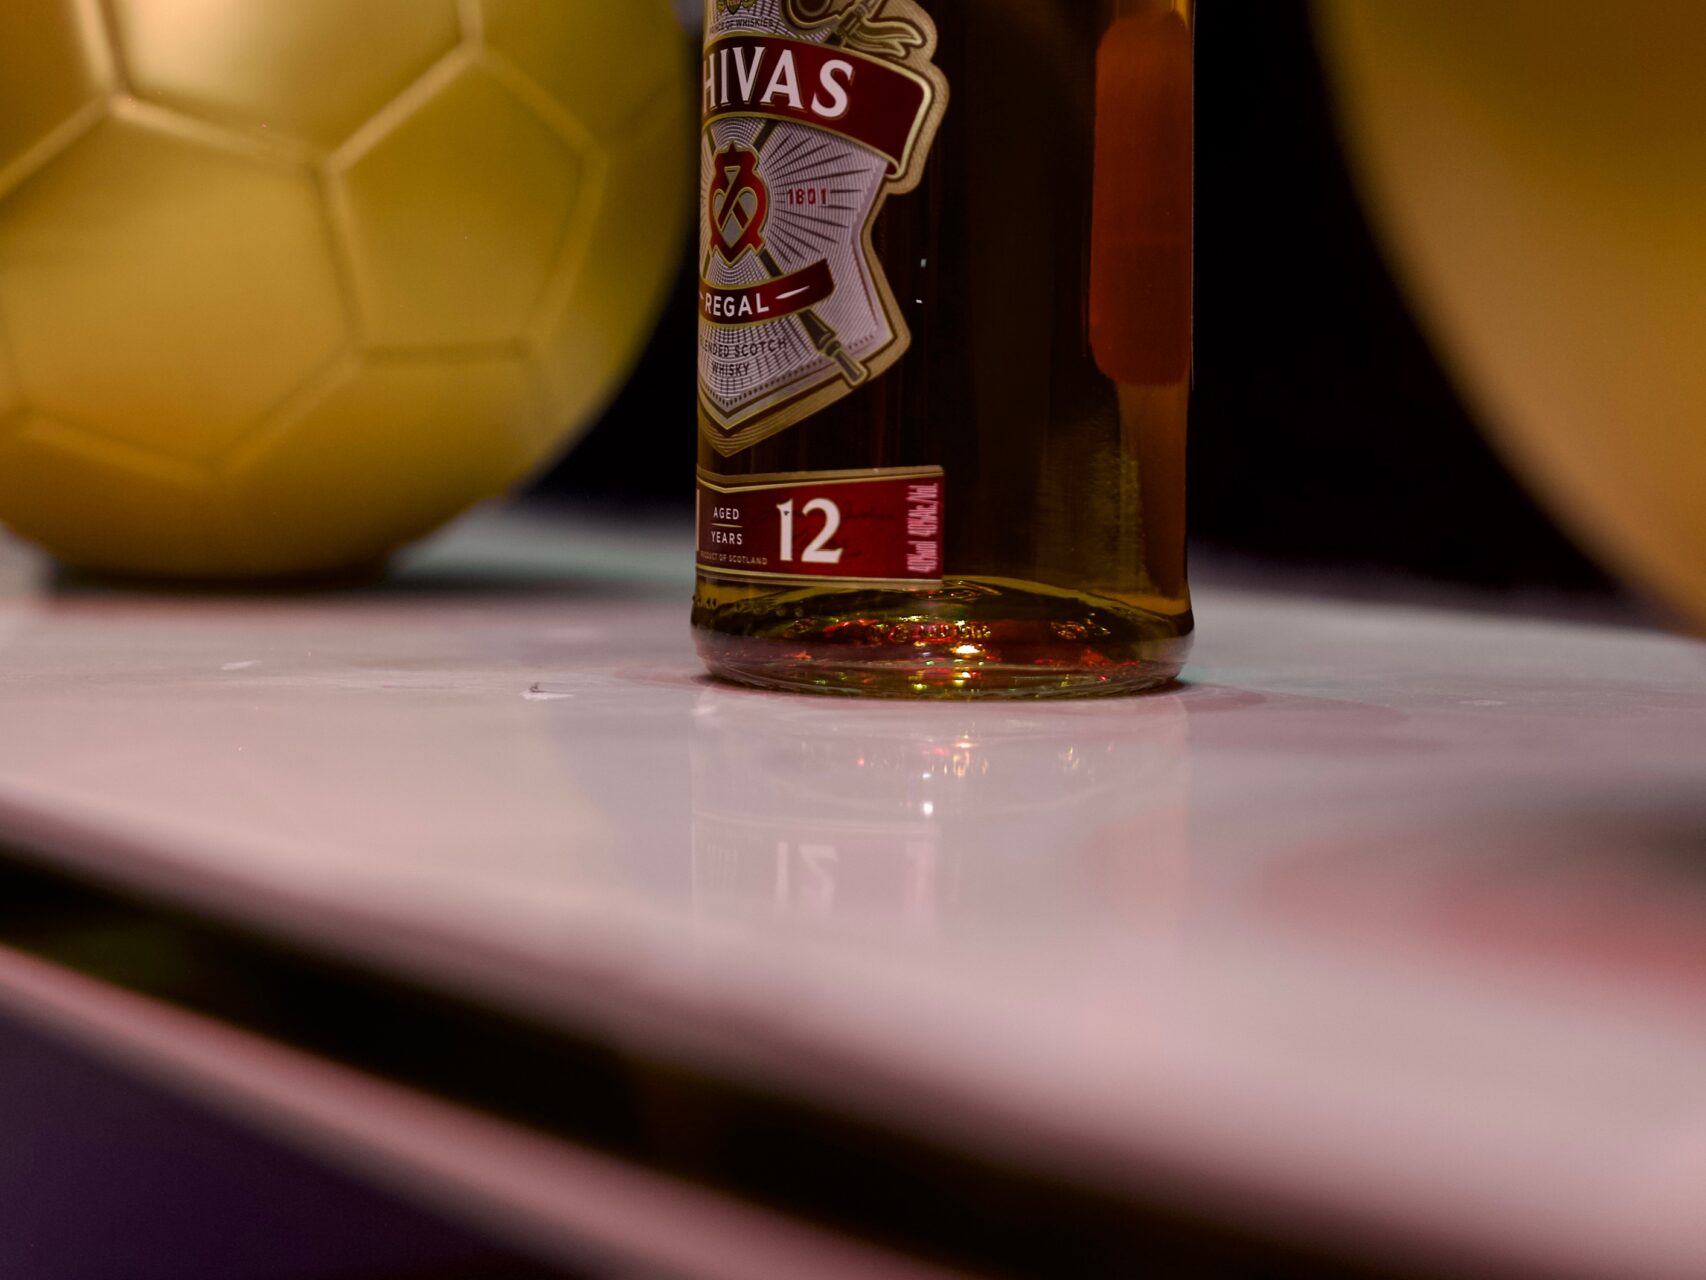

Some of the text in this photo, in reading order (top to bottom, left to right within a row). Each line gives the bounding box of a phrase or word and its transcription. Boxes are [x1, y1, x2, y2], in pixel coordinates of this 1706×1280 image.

[787, 187, 828, 205] 1801
[705, 292, 769, 317] REGAL
[734, 337, 787, 357] SCOTCH
[712, 360, 749, 376] WHISKY
[713, 506, 739, 520] AGED
[711, 531, 743, 545] YEARS
[776, 498, 843, 564] 12
